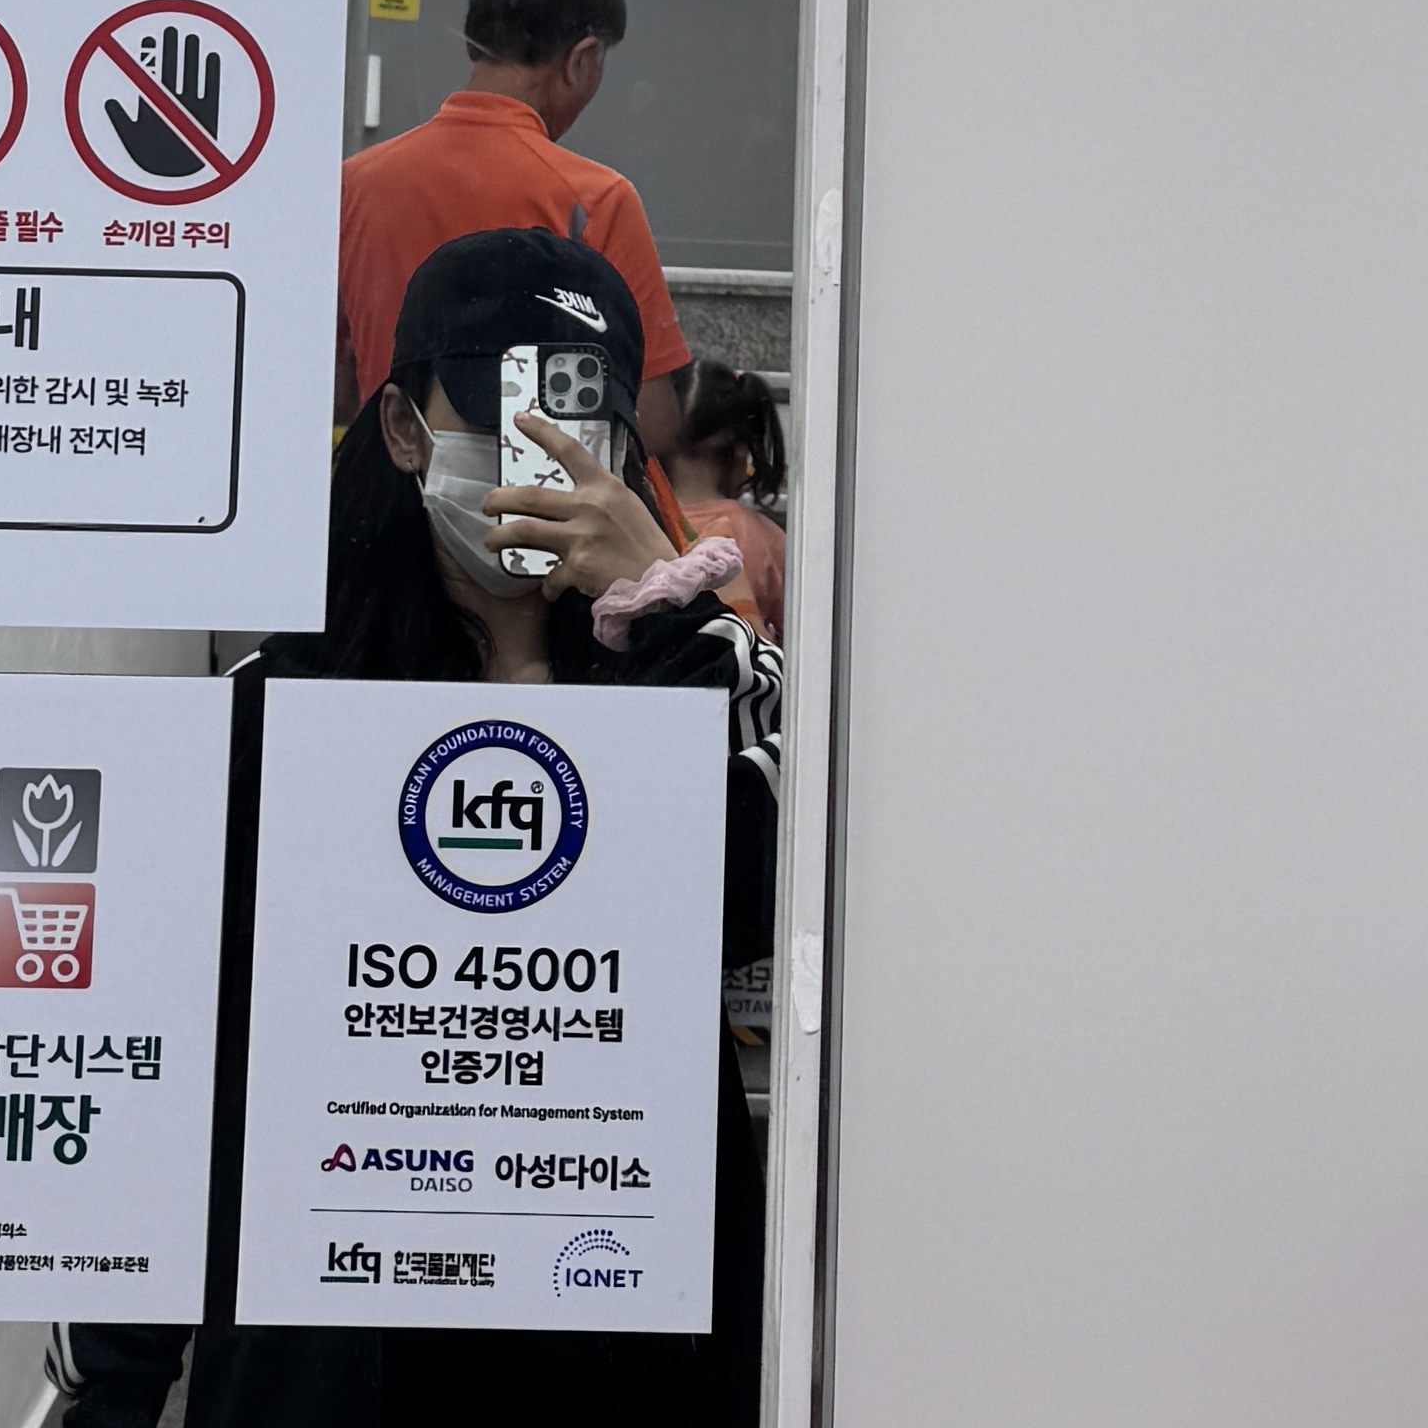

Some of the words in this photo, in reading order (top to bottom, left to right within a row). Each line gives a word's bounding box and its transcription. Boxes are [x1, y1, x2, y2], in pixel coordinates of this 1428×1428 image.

[15, 211, 63, 242] 필수
[103, 220, 175, 247] 손끼임
[182, 222, 229, 248] 주의
[46, 377, 95, 406] 감시
[106, 378, 128, 406] 및
[137, 379, 188, 407] 녹화
[70, 427, 145, 455] 전지역
[403, 763, 432, 825] KOREAN
[428, 725, 526, 764] FOUNDATION
[528, 735, 557, 762] FOR
[555, 760, 583, 829] QUALITY
[416, 858, 514, 908] MANAGEMENT
[519, 856, 572, 902] SYSTEM
[349, 944, 437, 989] ISO
[455, 947, 619, 993] 45001
[345, 1003, 623, 1042] 안전보건경영시스템
[421, 1049, 543, 1085] 인증기업
[479, 1104, 498, 1117] for
[501, 1105, 590, 1121] Management
[593, 1107, 643, 1122] System
[361, 1149, 474, 1173] ASUNG
[495, 1153, 650, 1191] 아성다이소
[411, 1178, 472, 1192] DAISO
[327, 1242, 382, 1284] kfq
[565, 1268, 644, 1288] IQNET
